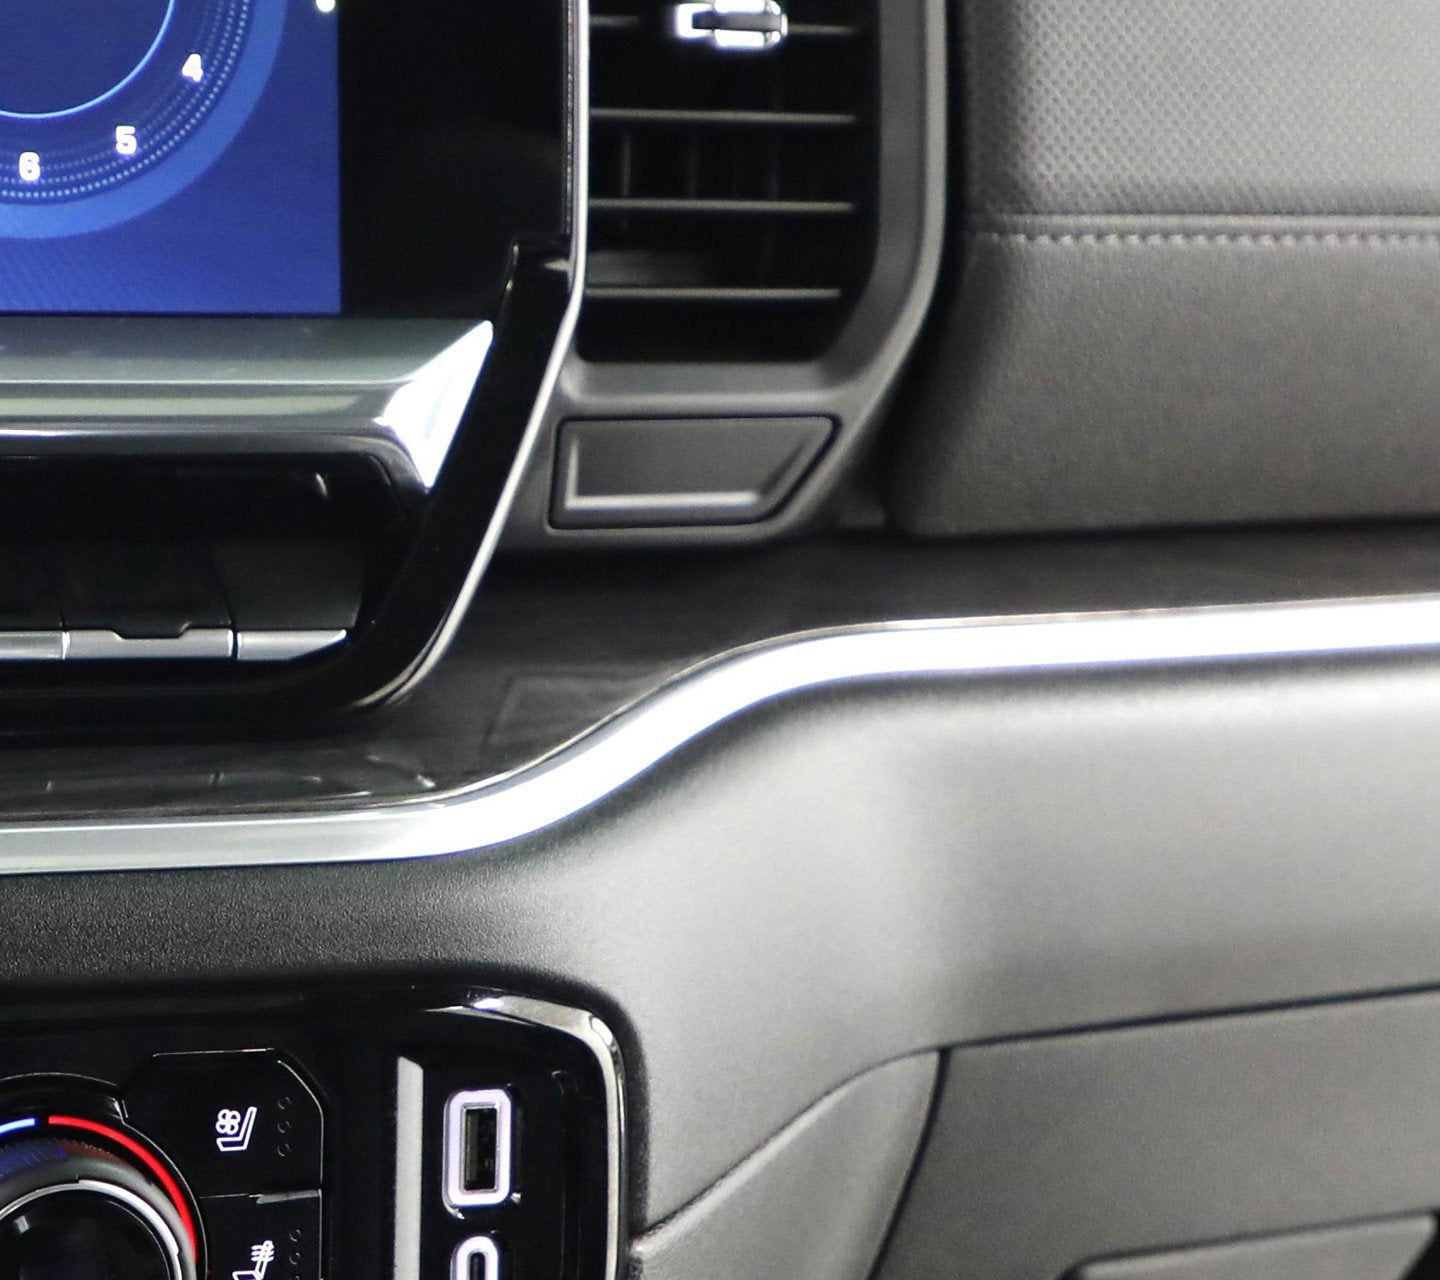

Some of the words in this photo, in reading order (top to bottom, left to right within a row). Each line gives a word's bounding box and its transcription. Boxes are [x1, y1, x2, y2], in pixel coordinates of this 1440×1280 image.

[181, 53, 204, 83] 4
[115, 125, 138, 157] 5
[18, 151, 41, 184] 6
